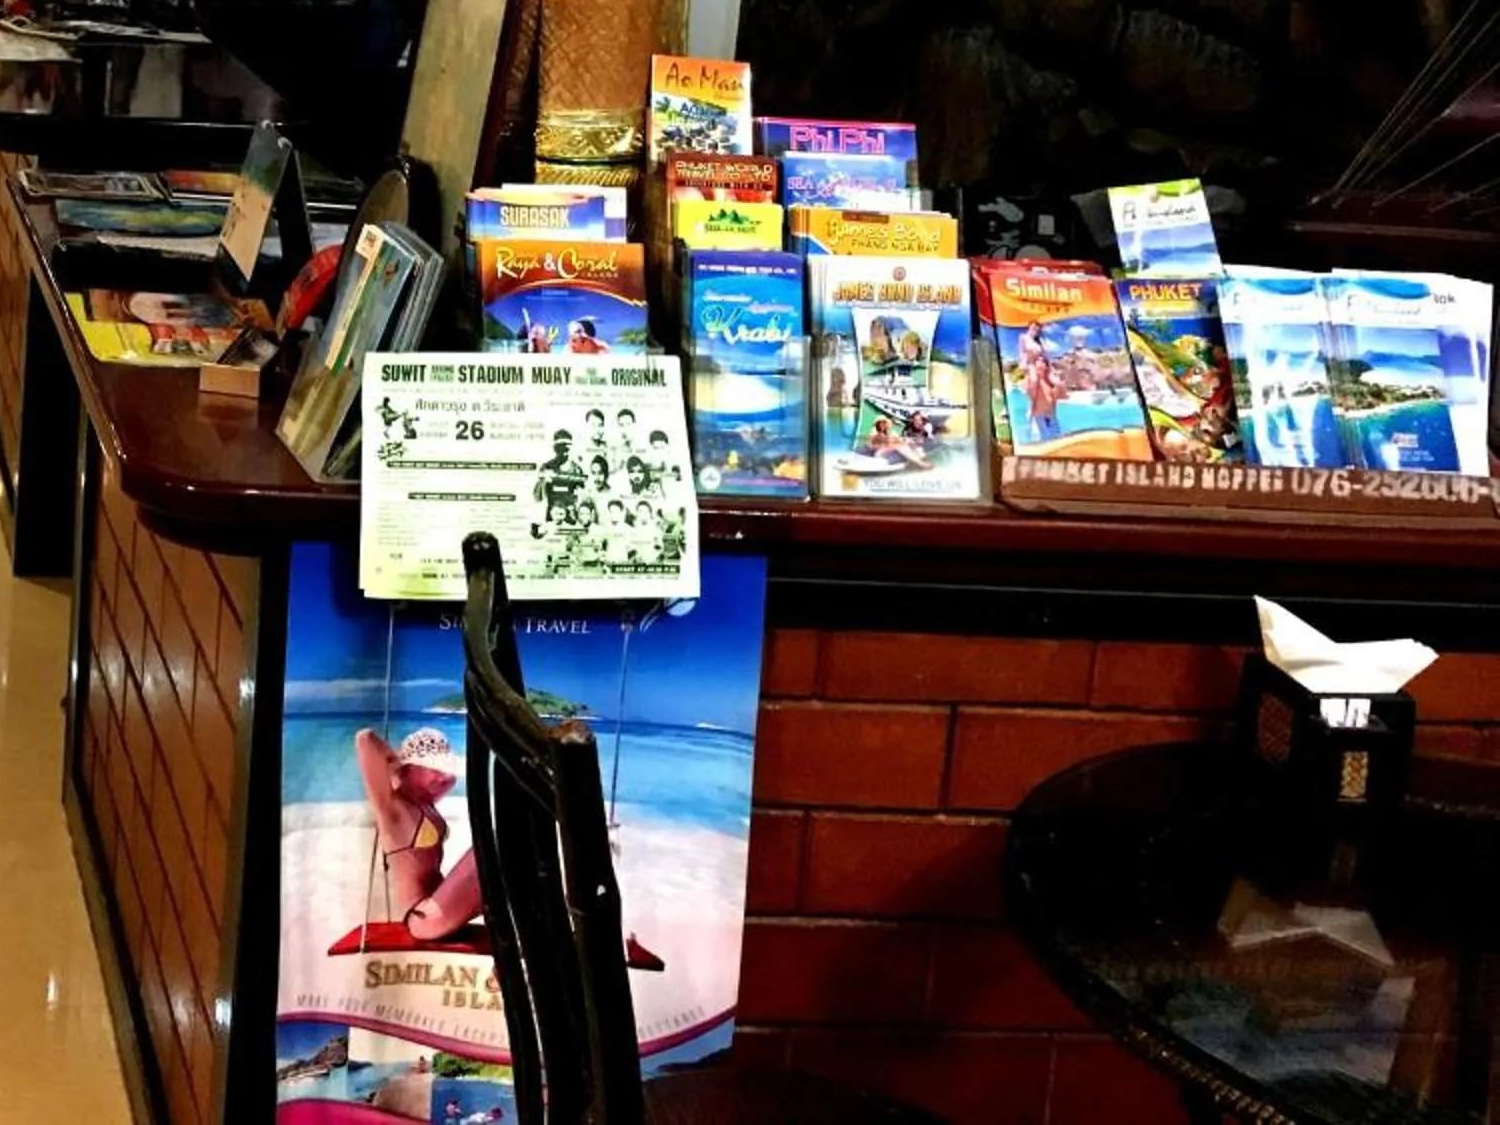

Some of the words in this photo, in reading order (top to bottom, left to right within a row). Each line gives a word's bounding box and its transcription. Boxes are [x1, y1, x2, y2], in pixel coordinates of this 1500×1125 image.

[789, 125, 835, 152] Phi
[839, 127, 886, 155] Phi
[500, 205, 570, 229] SURASAK
[495, 245, 541, 279] Raya
[543, 252, 557, 271] &
[557, 247, 619, 279] Coral
[1005, 277, 1082, 302] Similan
[1129, 282, 1202, 300] PHUKET
[381, 364, 427, 383] SUWIT
[457, 365, 525, 384] STADIUM
[531, 366, 572, 384] MUAY
[610, 367, 668, 387] ORIGINAL
[455, 420, 485, 440] 26
[1116, 463, 1196, 488] ISLAND
[525, 617, 593, 635] TRAVEL
[364, 959, 480, 989] SIMILAN
[441, 988, 504, 1012] ISLA
